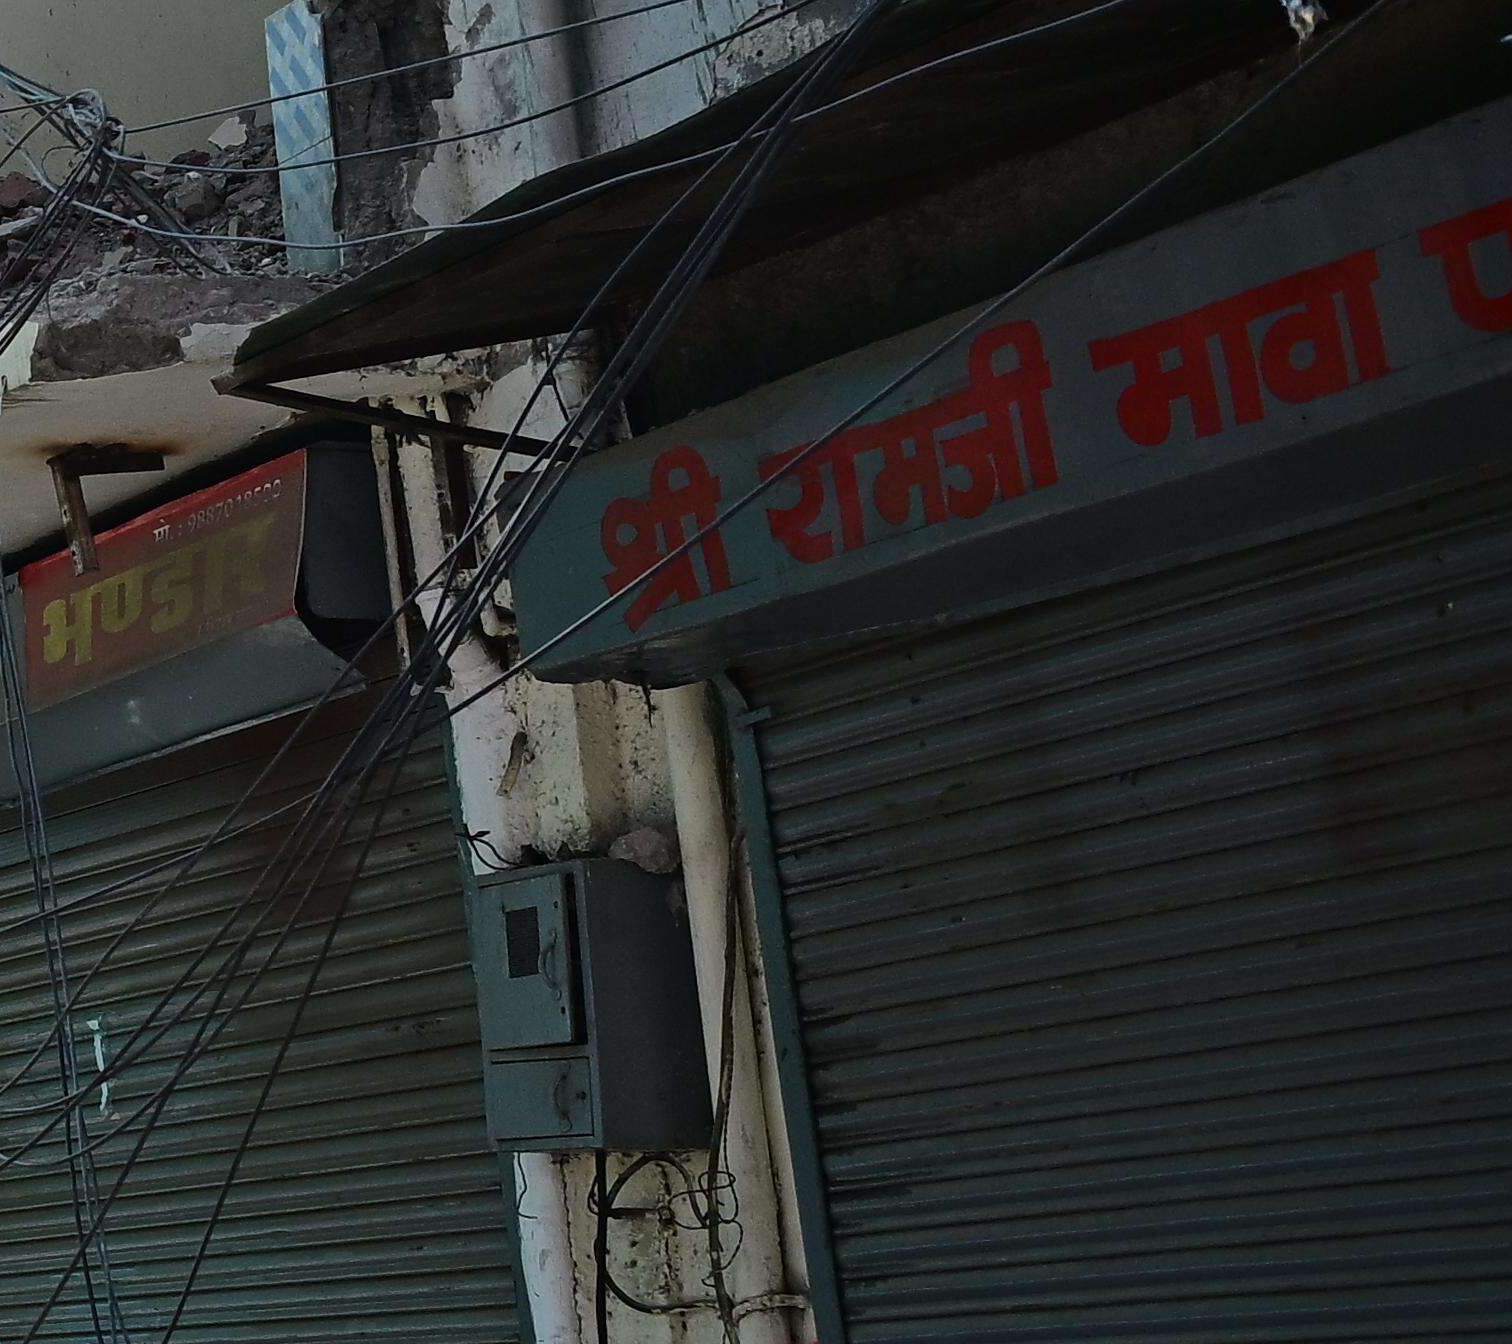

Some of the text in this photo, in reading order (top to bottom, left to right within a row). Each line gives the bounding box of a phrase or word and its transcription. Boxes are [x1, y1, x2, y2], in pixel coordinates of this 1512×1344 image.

[597, 443, 735, 634] श्री
[759, 317, 1061, 566] रामजी
[1086, 250, 1392, 447] मावा
[42, 511, 279, 666] भण्डार
